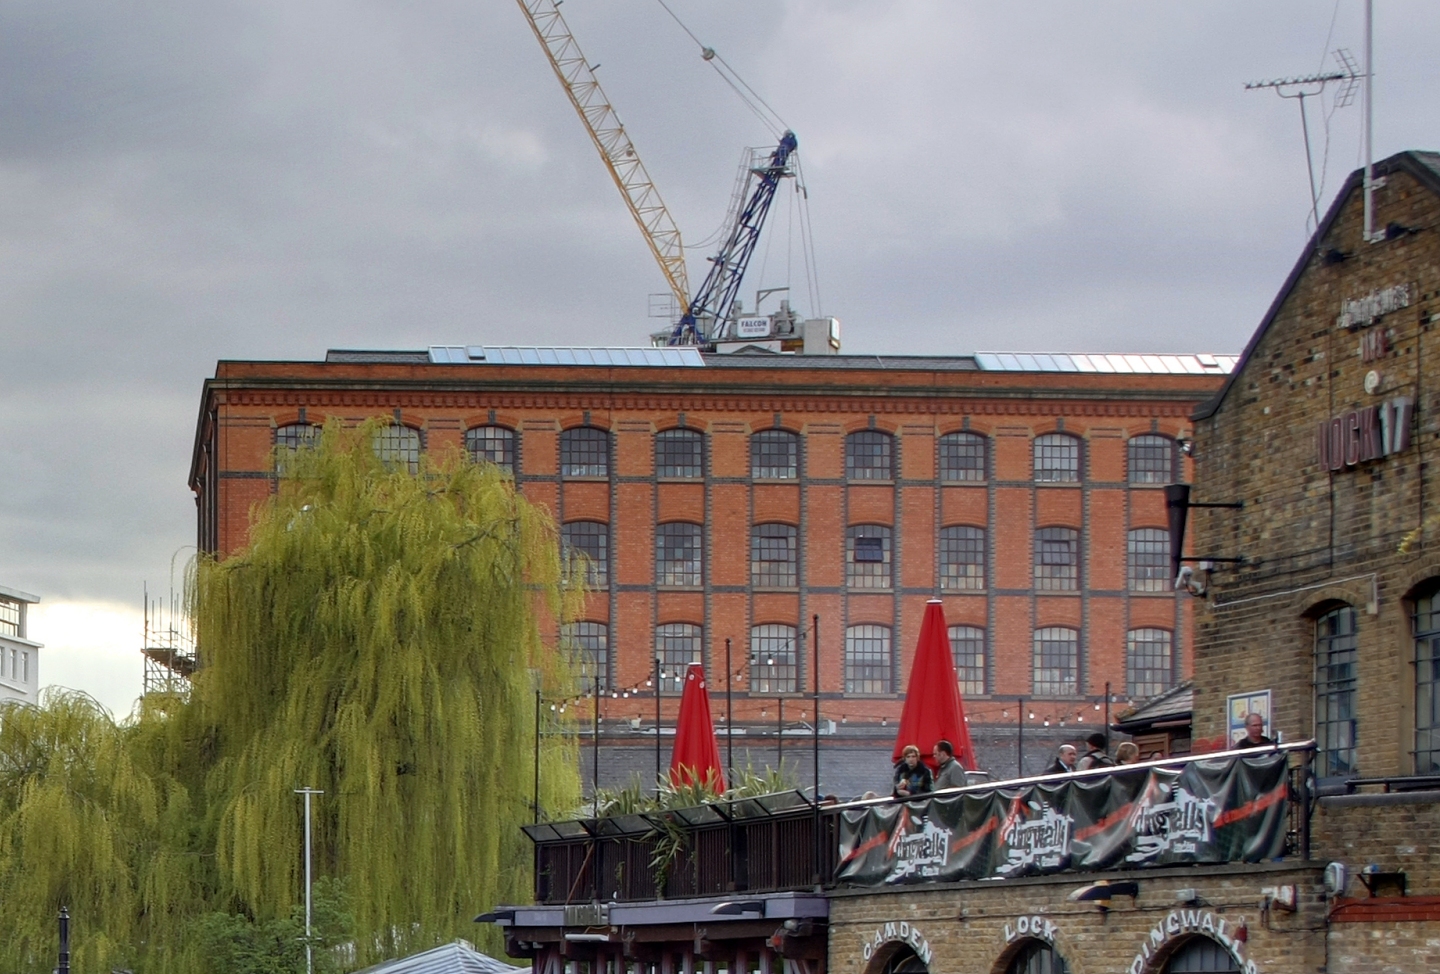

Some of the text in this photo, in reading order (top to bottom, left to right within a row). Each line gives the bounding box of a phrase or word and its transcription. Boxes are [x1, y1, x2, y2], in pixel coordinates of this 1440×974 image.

[1318, 396, 1414, 471] LOCK 17
[863, 921, 932, 964] CAMDEN
[1004, 916, 1058, 942] LOCK
